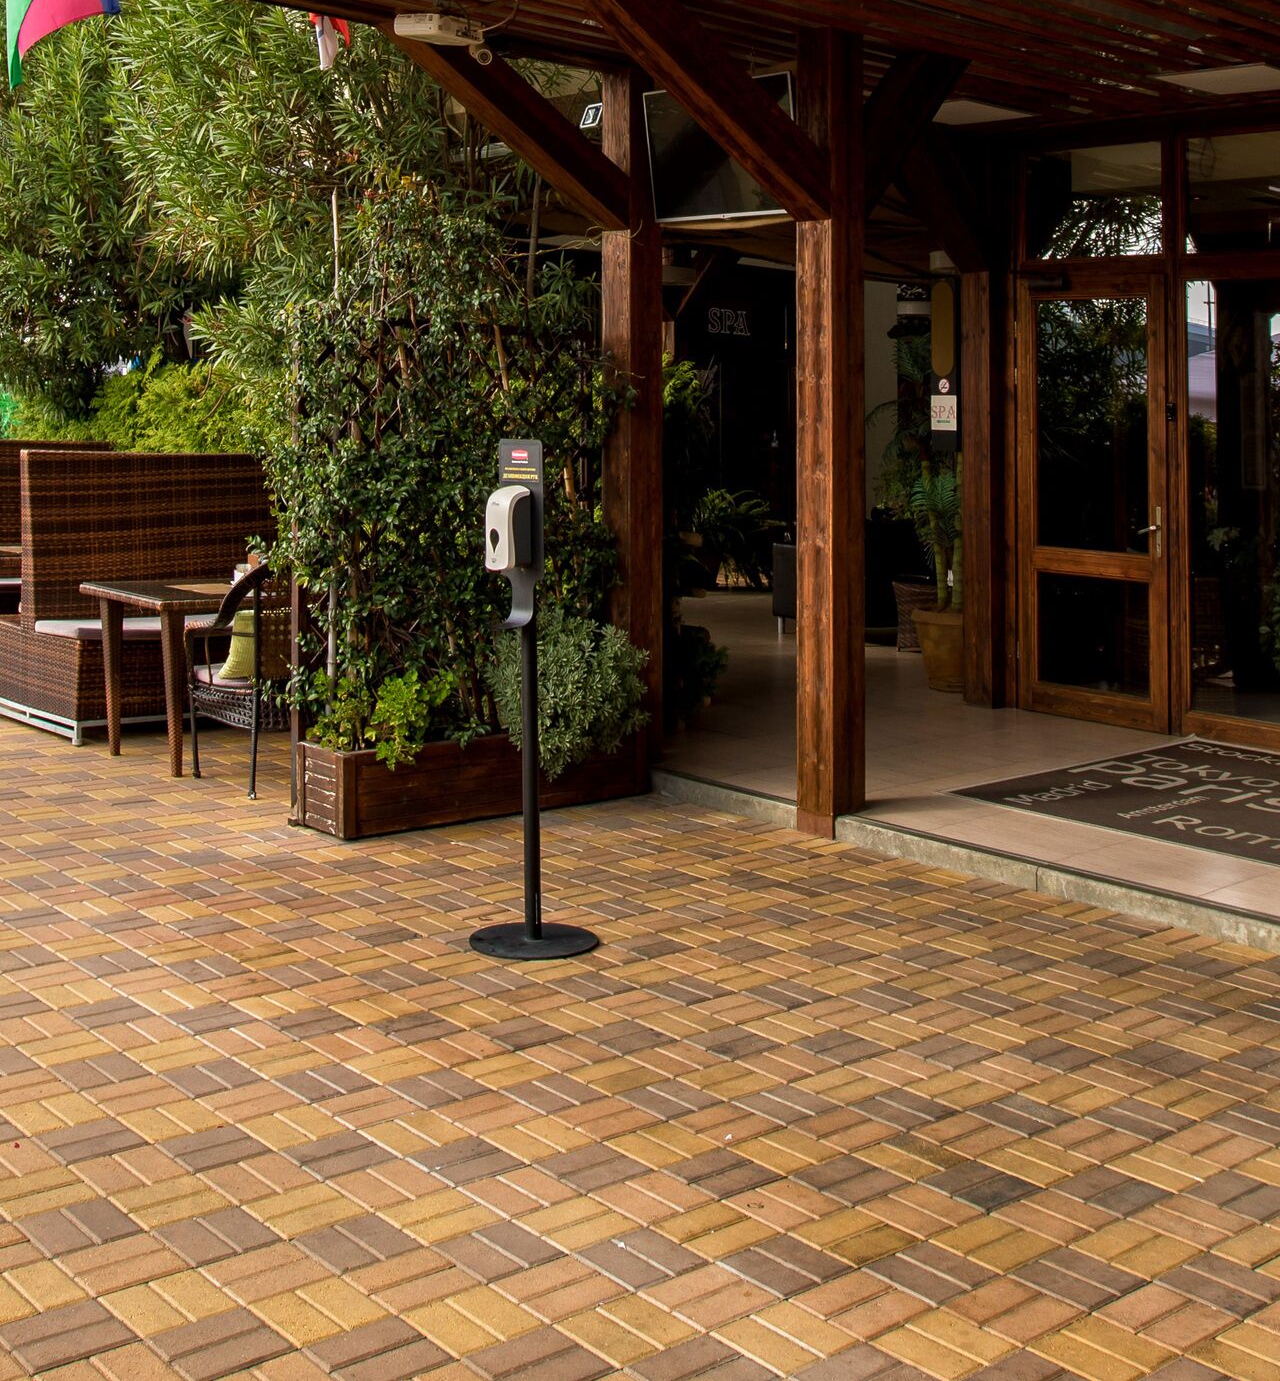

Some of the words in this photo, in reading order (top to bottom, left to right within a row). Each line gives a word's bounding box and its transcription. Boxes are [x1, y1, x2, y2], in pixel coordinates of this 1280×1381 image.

[708, 307, 751, 336] SPA
[931, 405, 956, 419] SPA
[1133, 753, 1280, 789] Tokyo
[1003, 779, 1114, 807] Madrid
[1117, 794, 1211, 820] Amsterdam
